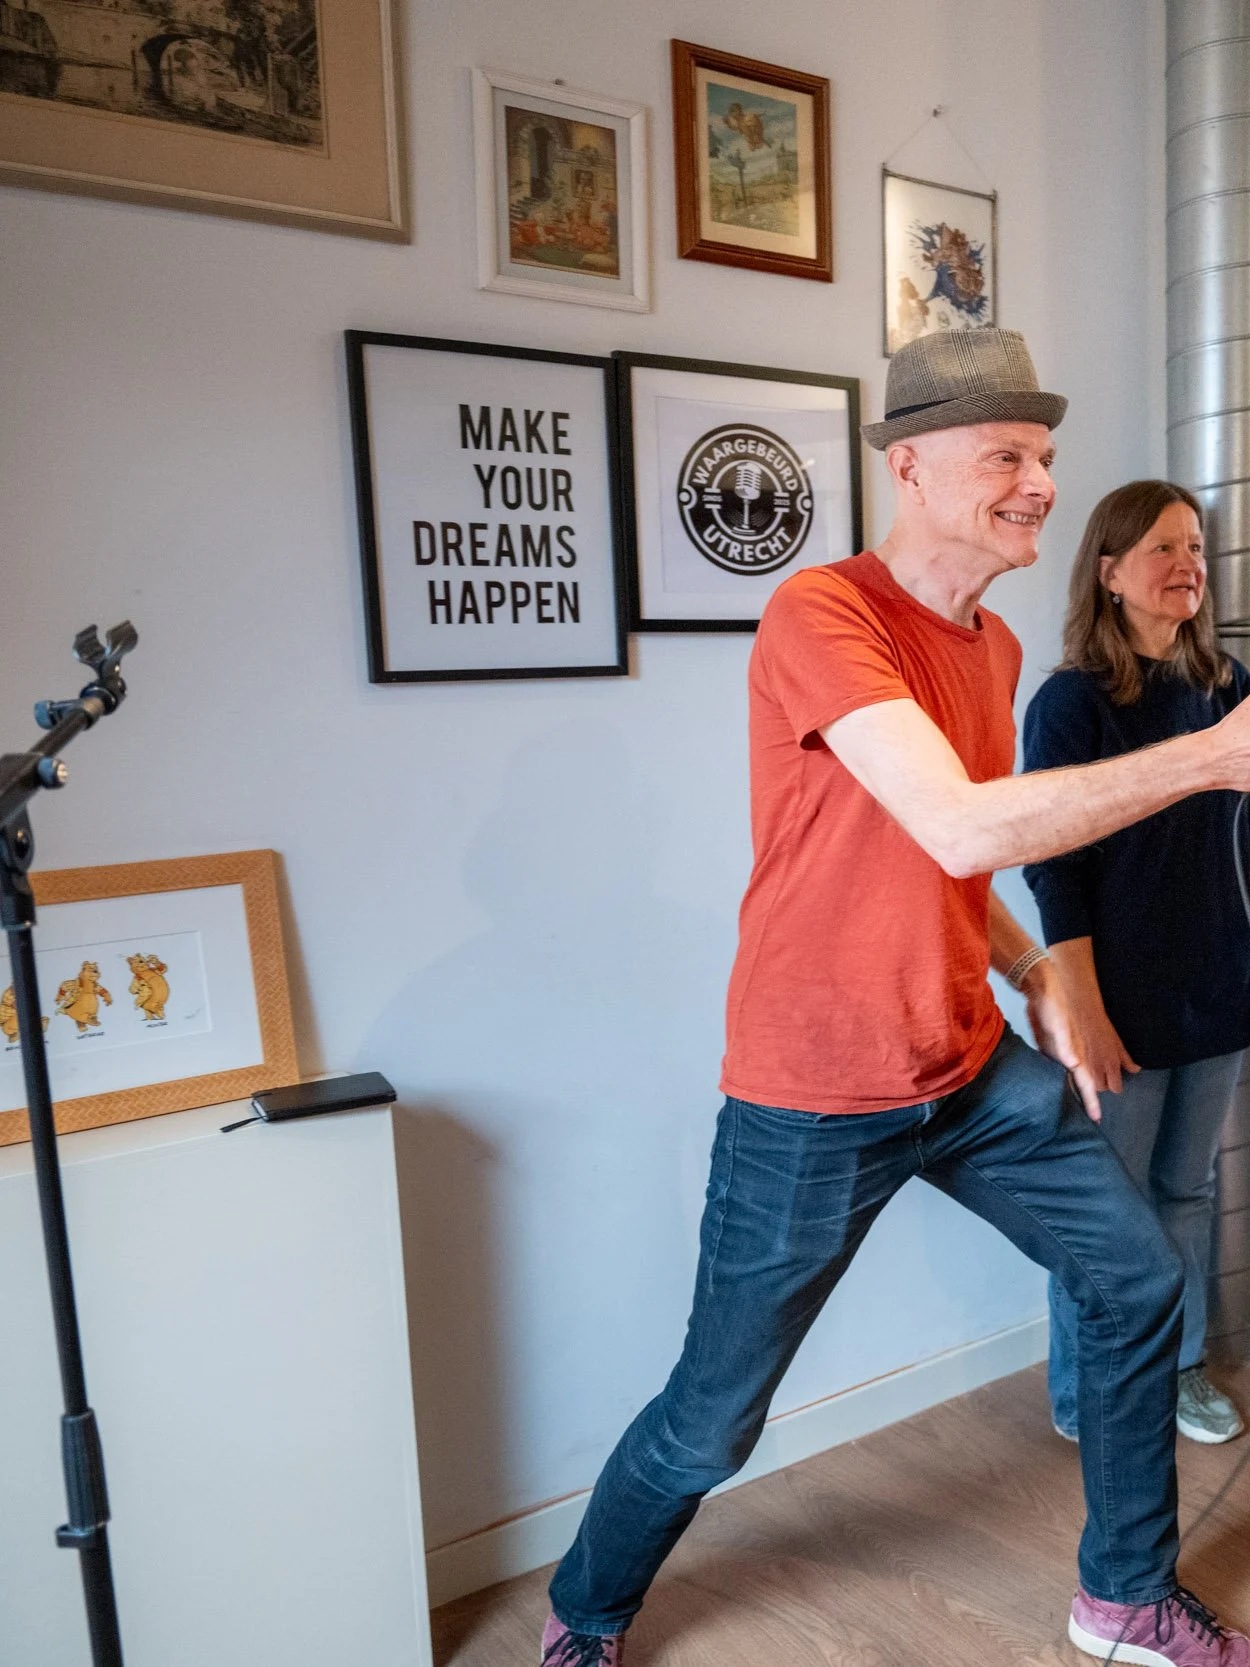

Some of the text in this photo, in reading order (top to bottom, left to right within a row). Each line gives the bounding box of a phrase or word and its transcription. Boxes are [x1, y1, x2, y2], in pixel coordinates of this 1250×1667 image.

[458, 403, 572, 456] MAKE
[472, 463, 575, 513] YOUR
[692, 438, 799, 491] WAARGEBEURD
[412, 520, 577, 569] DREAMS
[702, 523, 792, 562] UTRECHT
[427, 579, 581, 625] HAPPEN
